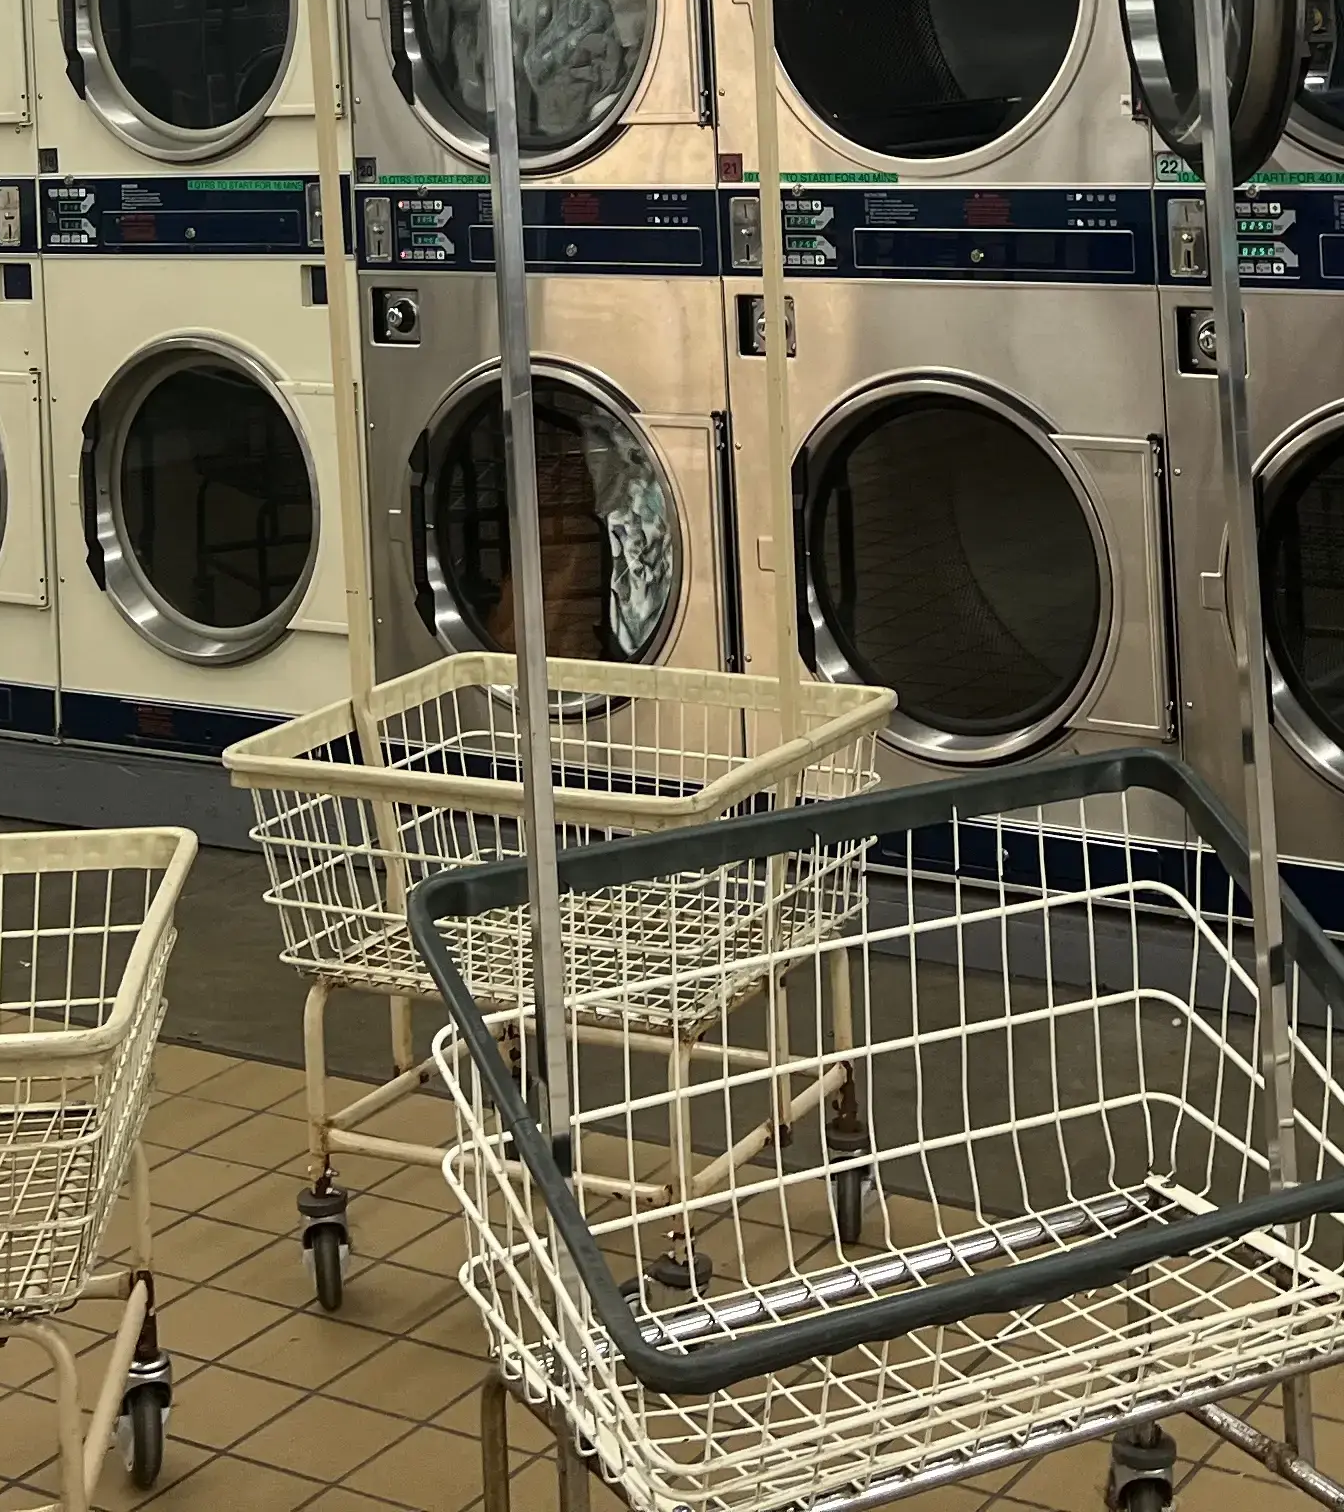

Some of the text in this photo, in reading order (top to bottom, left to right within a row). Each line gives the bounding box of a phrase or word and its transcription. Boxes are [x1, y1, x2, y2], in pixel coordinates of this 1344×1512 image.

[723, 162, 737, 175] 21
[1160, 160, 1178, 174] 22
[1289, 173, 1314, 183] FOR
